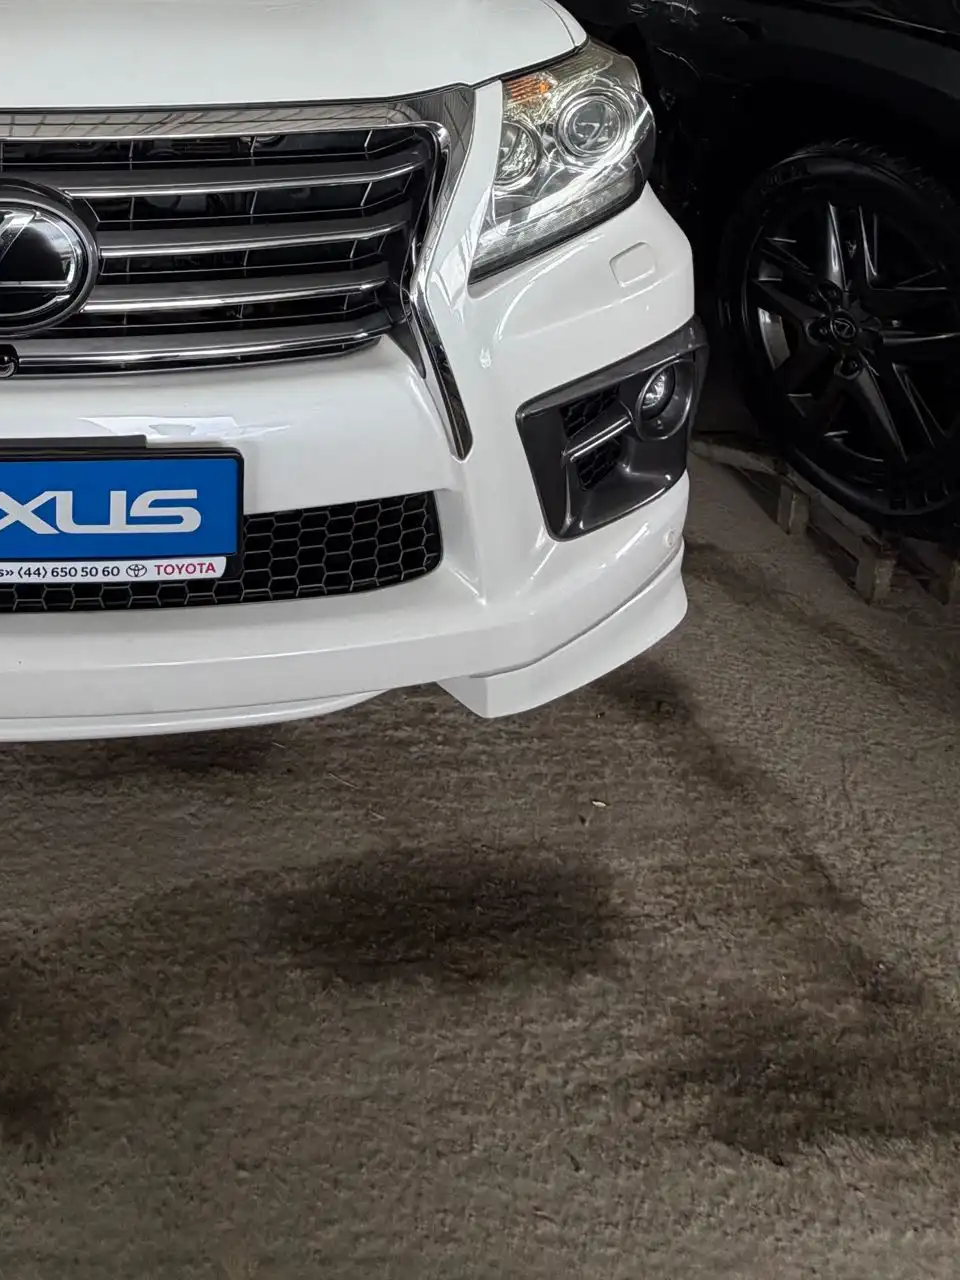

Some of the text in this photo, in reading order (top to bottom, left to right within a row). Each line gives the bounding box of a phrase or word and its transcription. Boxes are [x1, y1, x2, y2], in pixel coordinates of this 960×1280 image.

[50, 566, 78, 578] 650
[80, 566, 99, 578] 50
[101, 565, 120, 577] 60
[154, 562, 217, 576] TOYOTA
